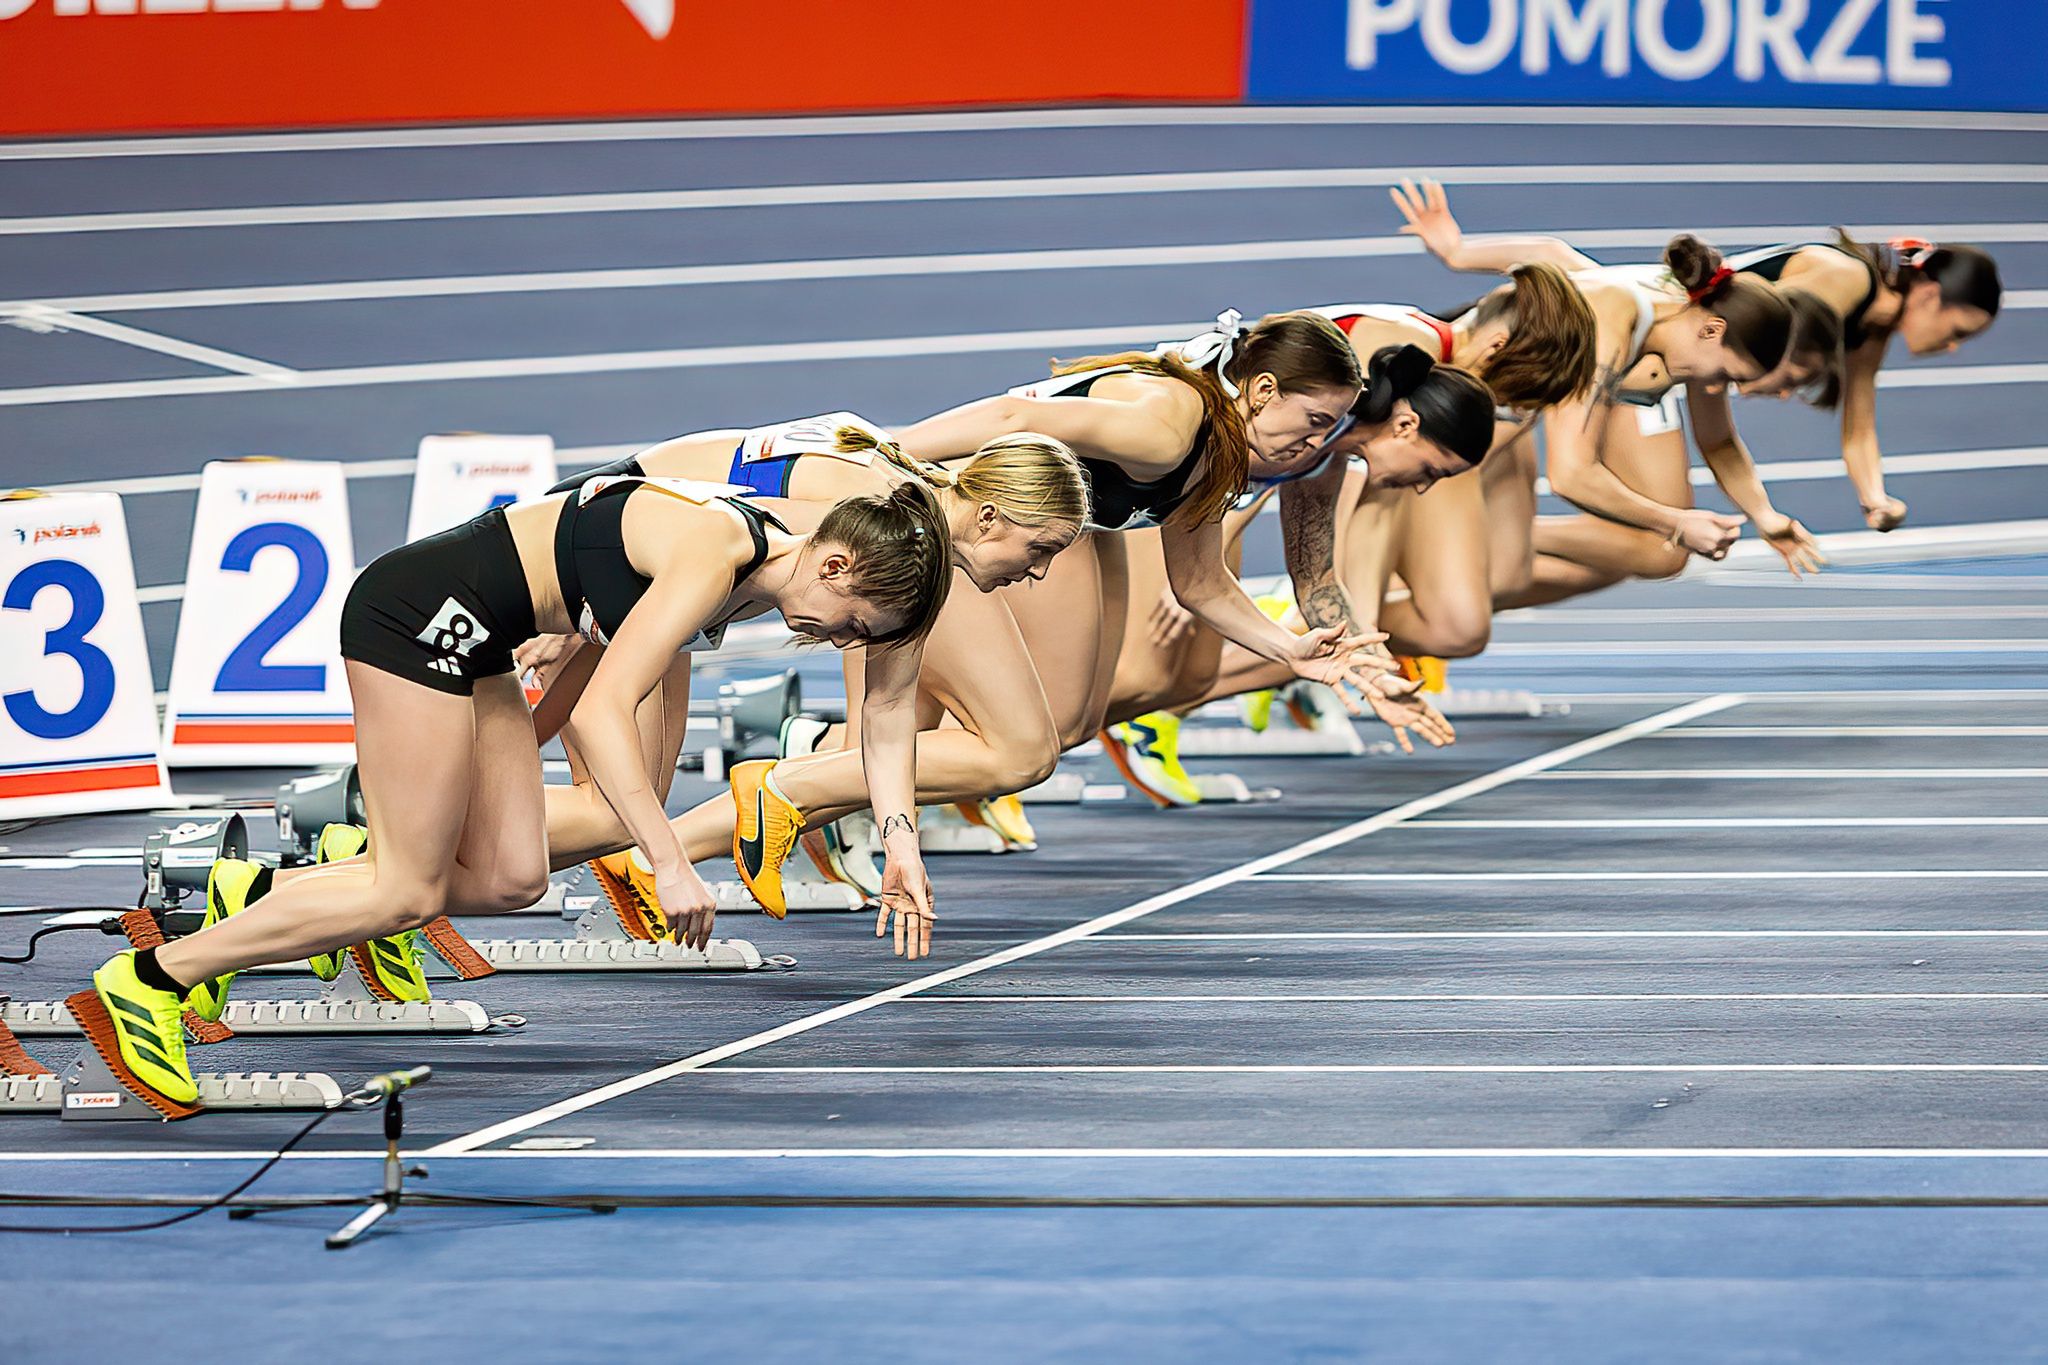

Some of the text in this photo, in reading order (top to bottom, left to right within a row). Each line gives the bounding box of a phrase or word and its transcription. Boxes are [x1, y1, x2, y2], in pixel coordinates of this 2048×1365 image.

[1345, 0, 1952, 87] POMORZE
[2, 559, 116, 740] 3
[213, 522, 329, 692] 2
[433, 613, 474, 656] 8
